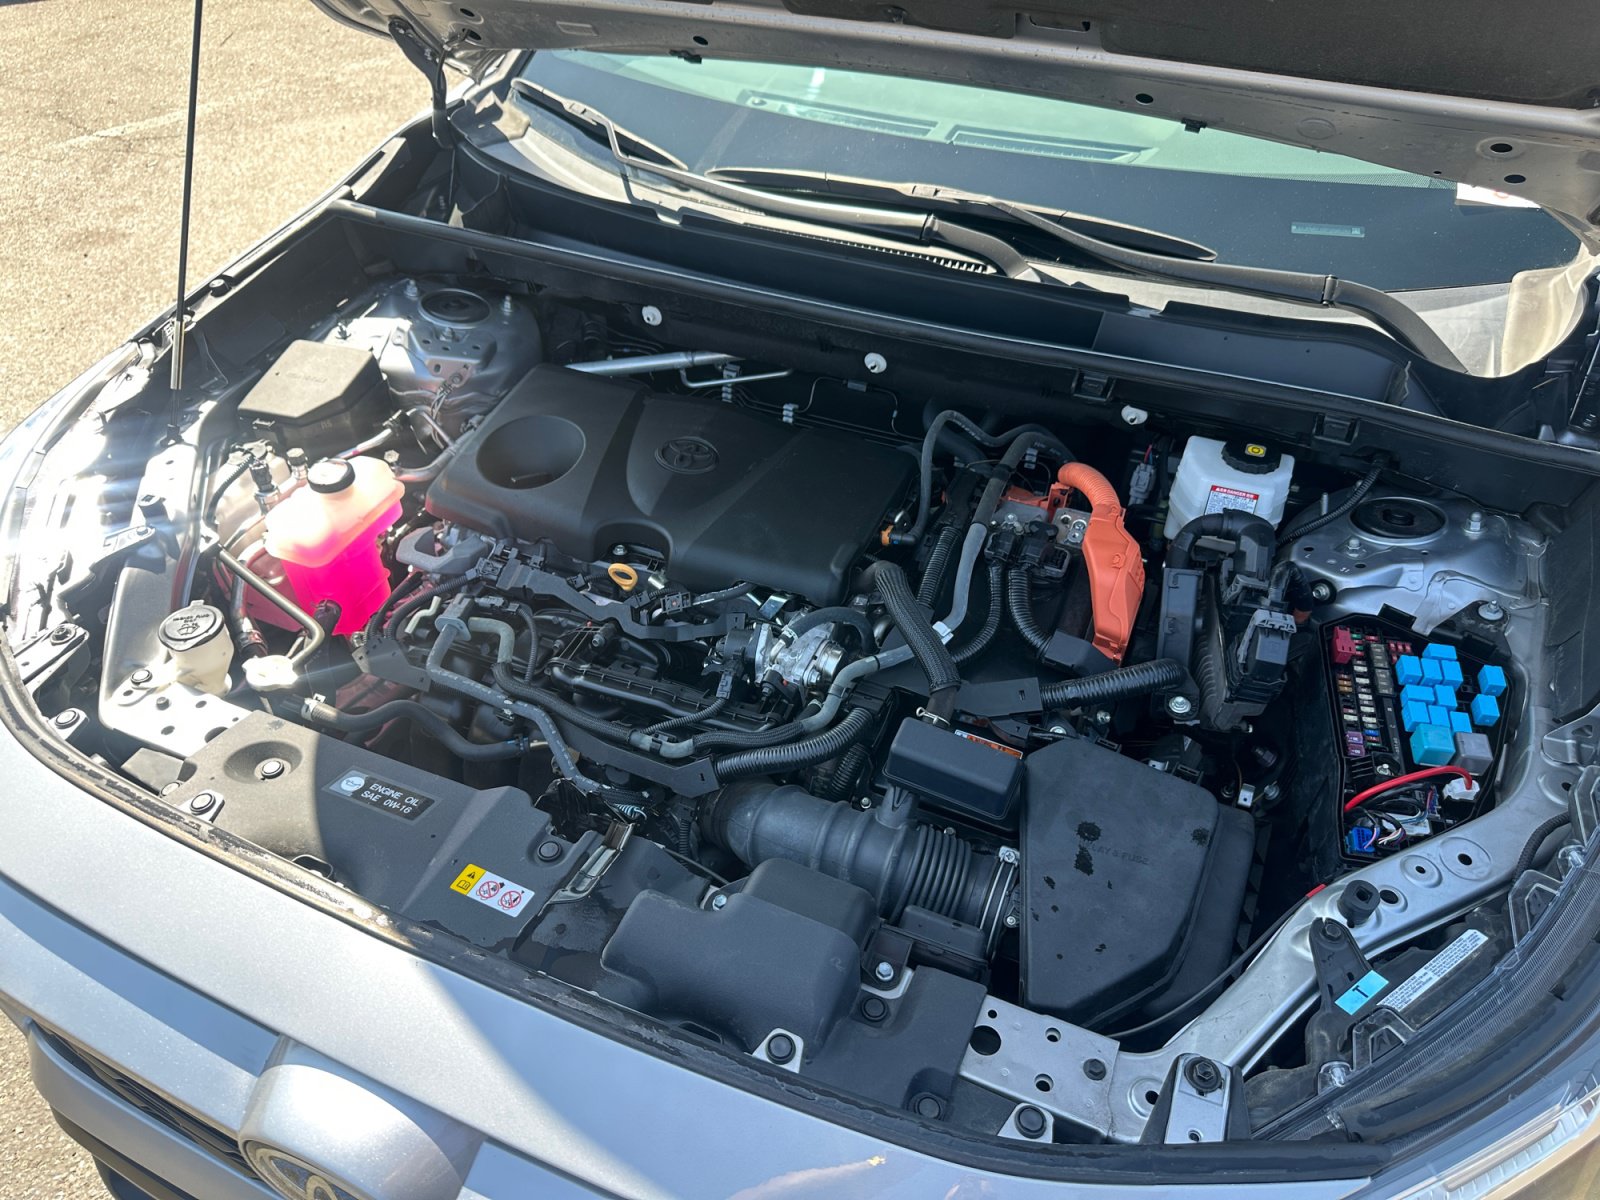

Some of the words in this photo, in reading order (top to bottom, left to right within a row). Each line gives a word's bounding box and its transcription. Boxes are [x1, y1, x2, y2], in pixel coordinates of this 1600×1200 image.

[361, 790, 382, 801] SAE
[383, 799, 413, 814] 0W-16
[369, 783, 403, 799] ENGINE
[404, 796, 420, 807] OIL
[1352, 984, 1369, 998] T
